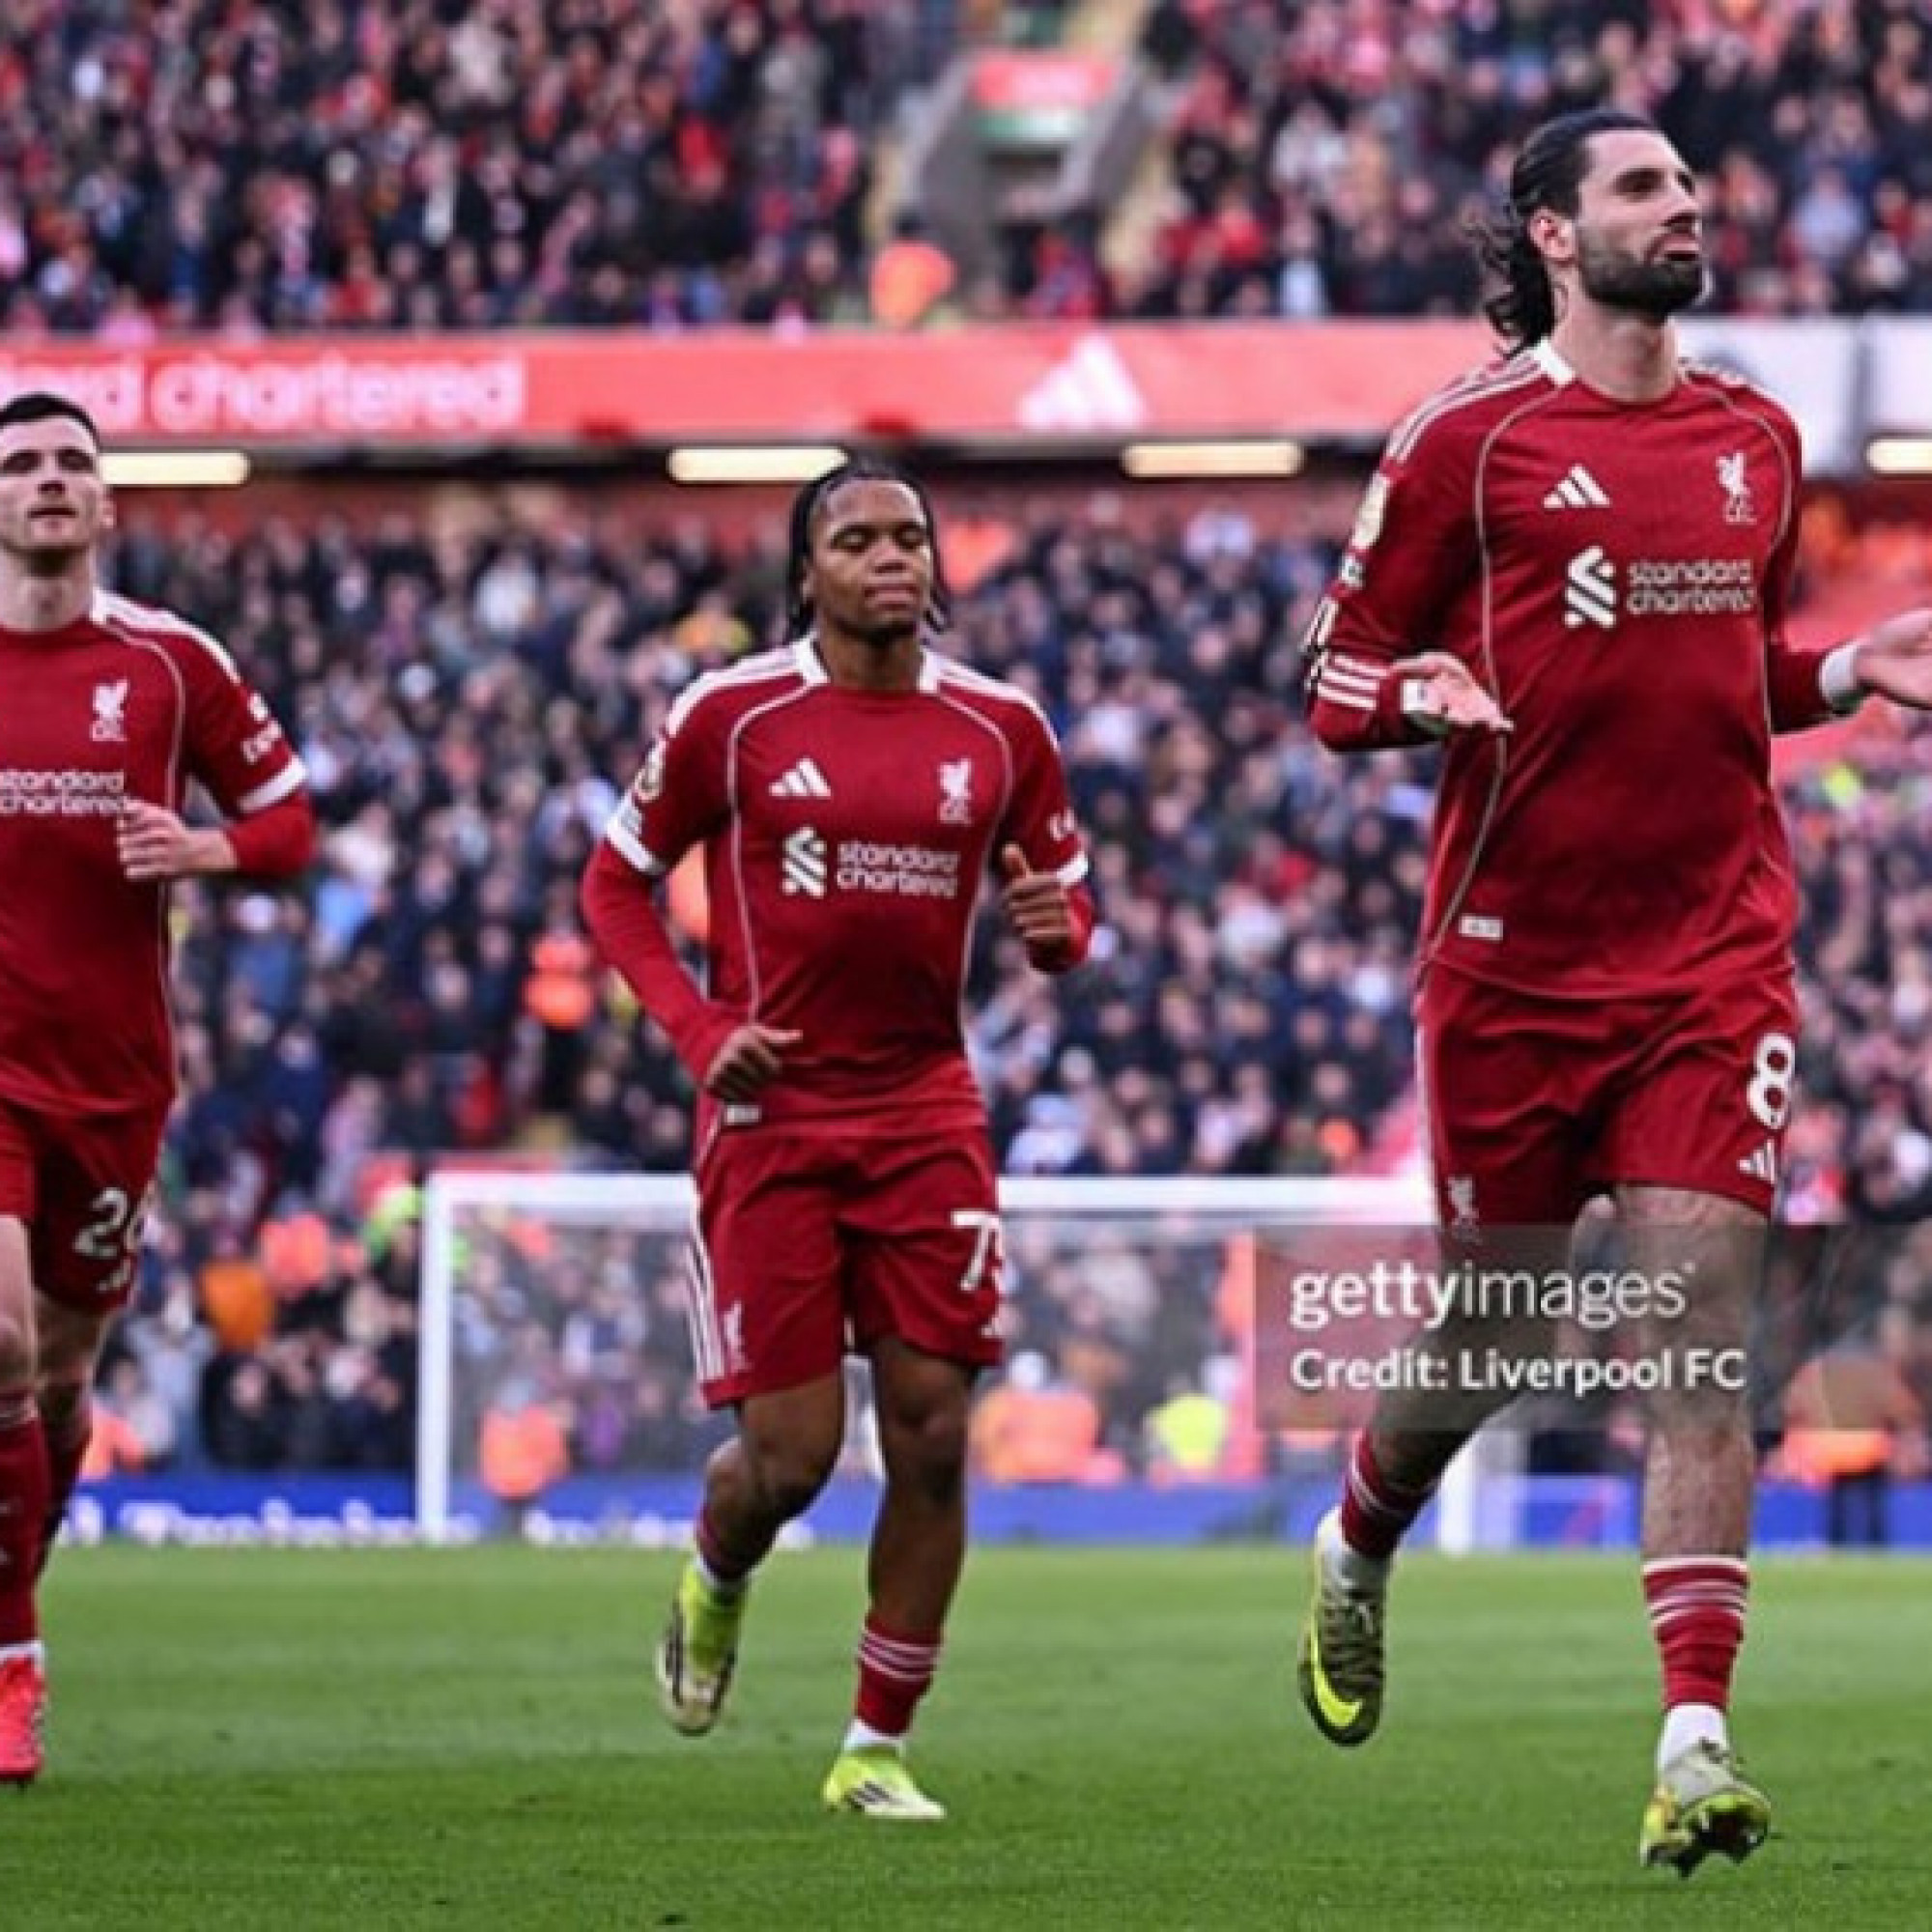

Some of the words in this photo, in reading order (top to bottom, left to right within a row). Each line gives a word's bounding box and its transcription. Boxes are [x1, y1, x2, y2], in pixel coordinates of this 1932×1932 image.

[1627, 558, 1751, 585] standard
[1627, 584, 1755, 615] chartered
[838, 840, 960, 870] standard
[837, 867, 959, 897] chartered
[1746, 1033, 1796, 1131] 8
[949, 1208, 1003, 1296] 7
